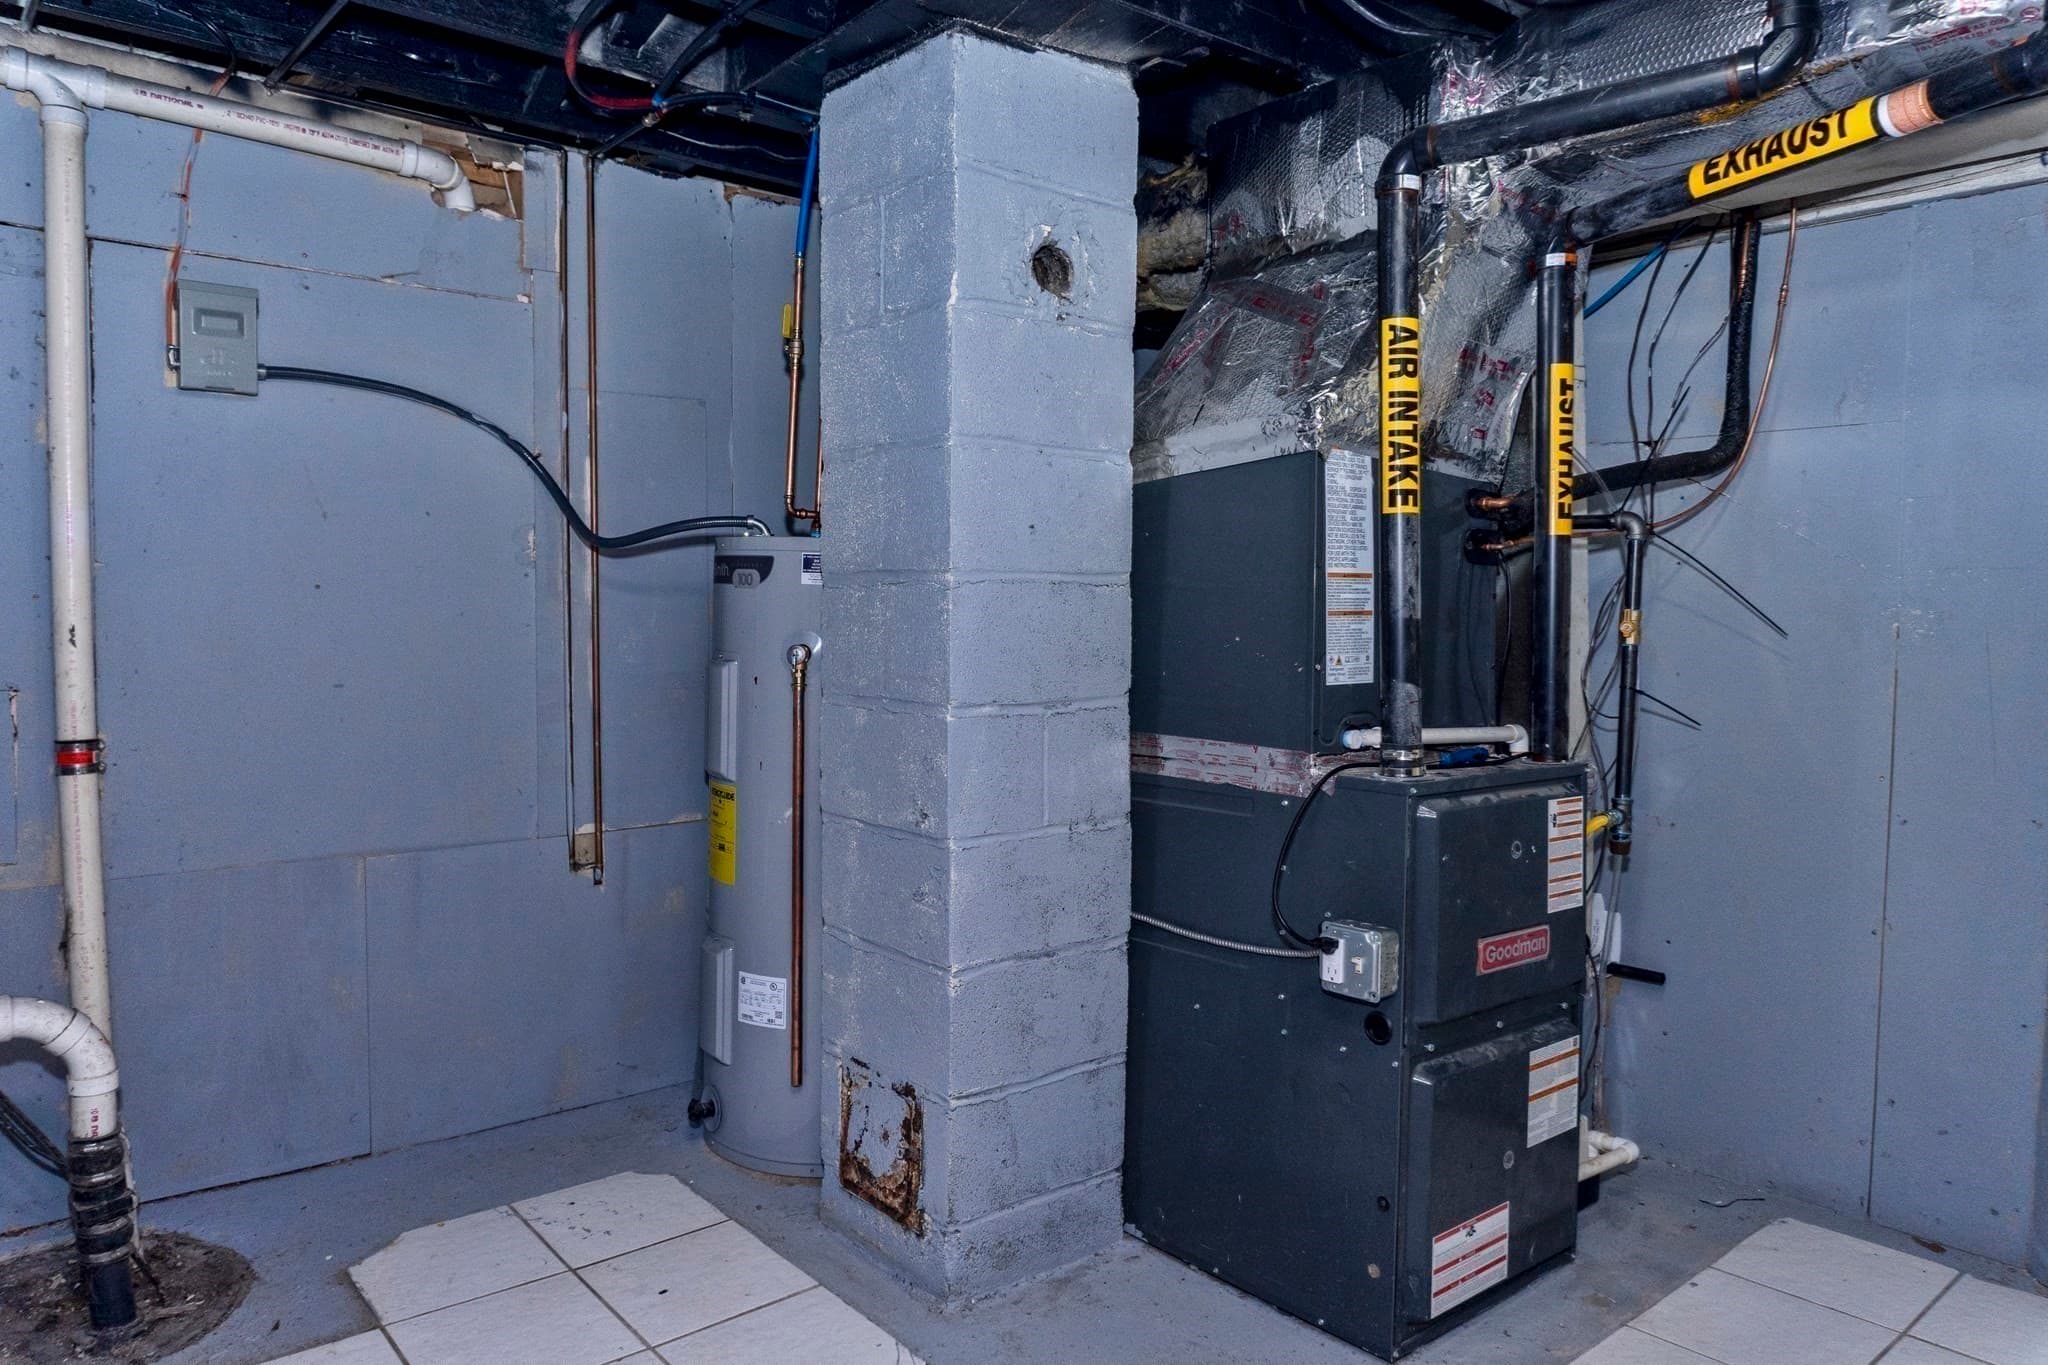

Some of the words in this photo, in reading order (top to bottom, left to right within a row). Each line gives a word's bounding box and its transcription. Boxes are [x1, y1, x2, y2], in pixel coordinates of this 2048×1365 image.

[1702, 103, 1857, 185] EXHAUST
[1388, 324, 1418, 379] AIR
[1388, 390, 1418, 508] INTAKE
[1485, 936, 1546, 963] Goodman
